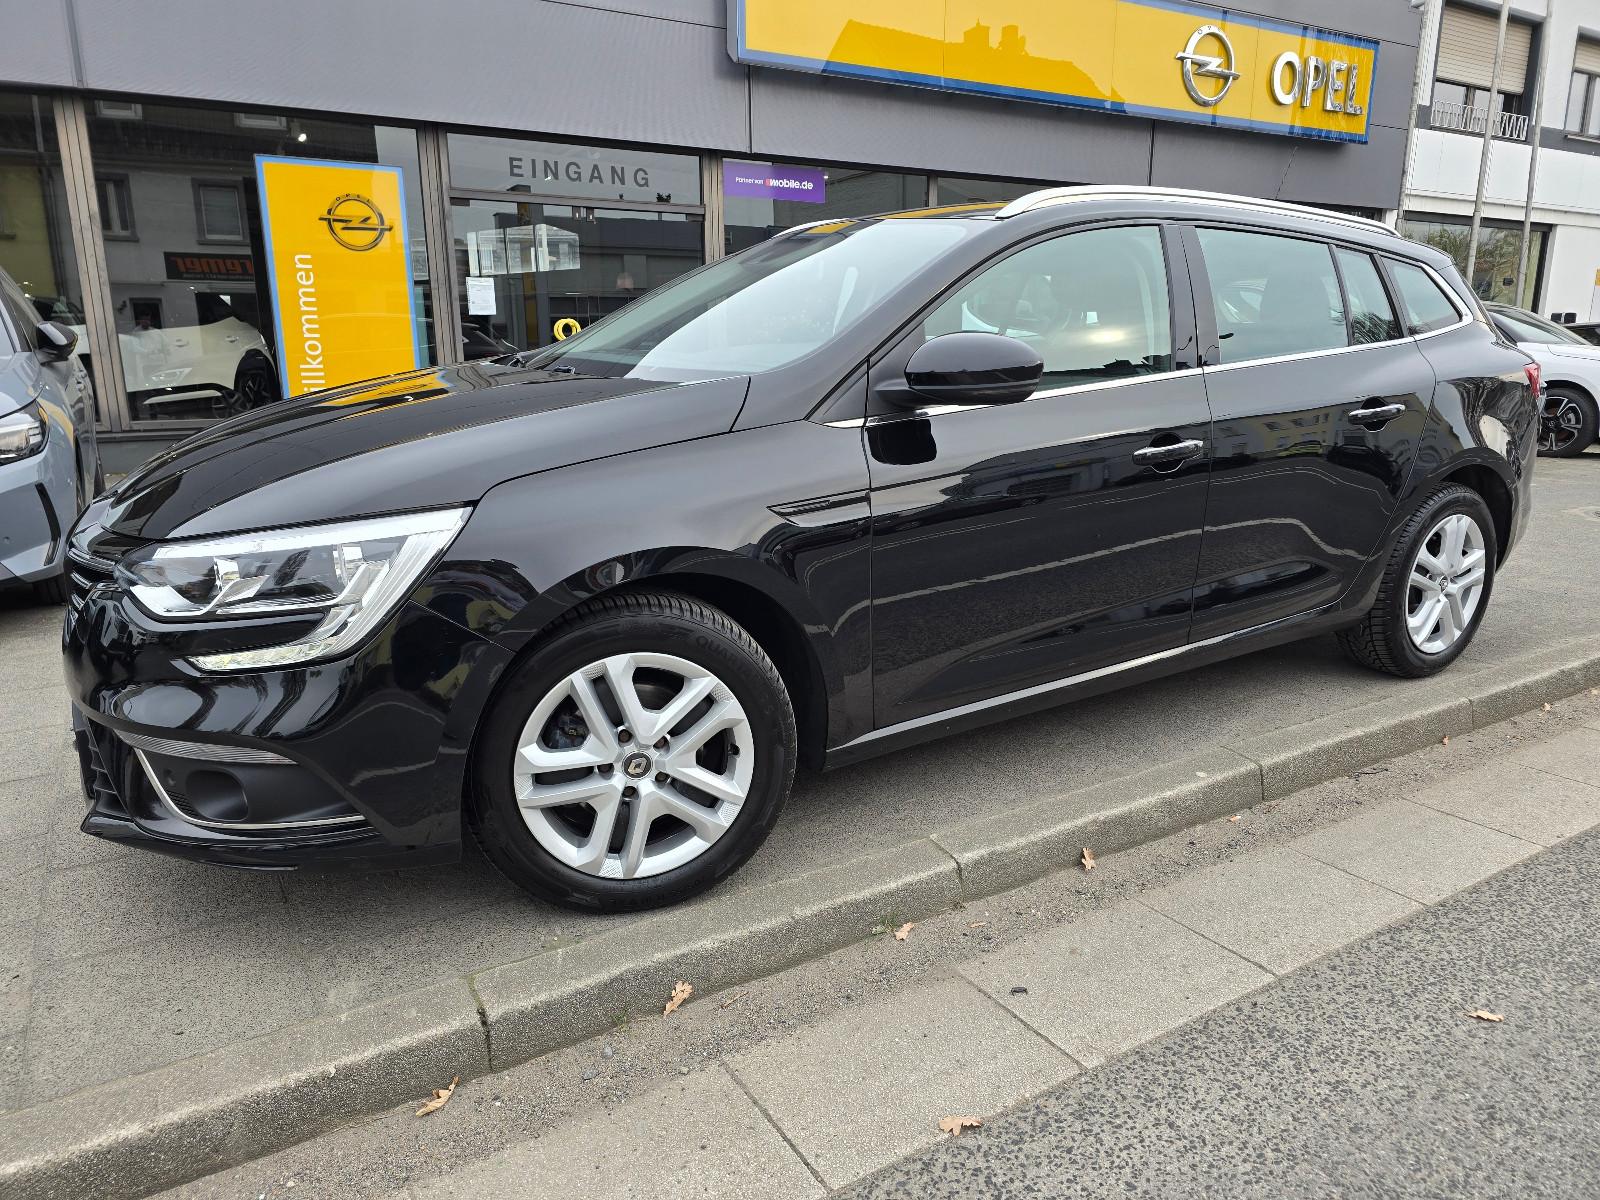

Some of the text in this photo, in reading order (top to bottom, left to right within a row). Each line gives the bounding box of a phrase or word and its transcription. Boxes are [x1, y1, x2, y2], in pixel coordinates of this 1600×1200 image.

[1270, 51, 1363, 115] OPEL
[508, 156, 649, 188] EINGANG
[768, 178, 814, 190] mobile.de
[294, 254, 326, 391] illkommen
